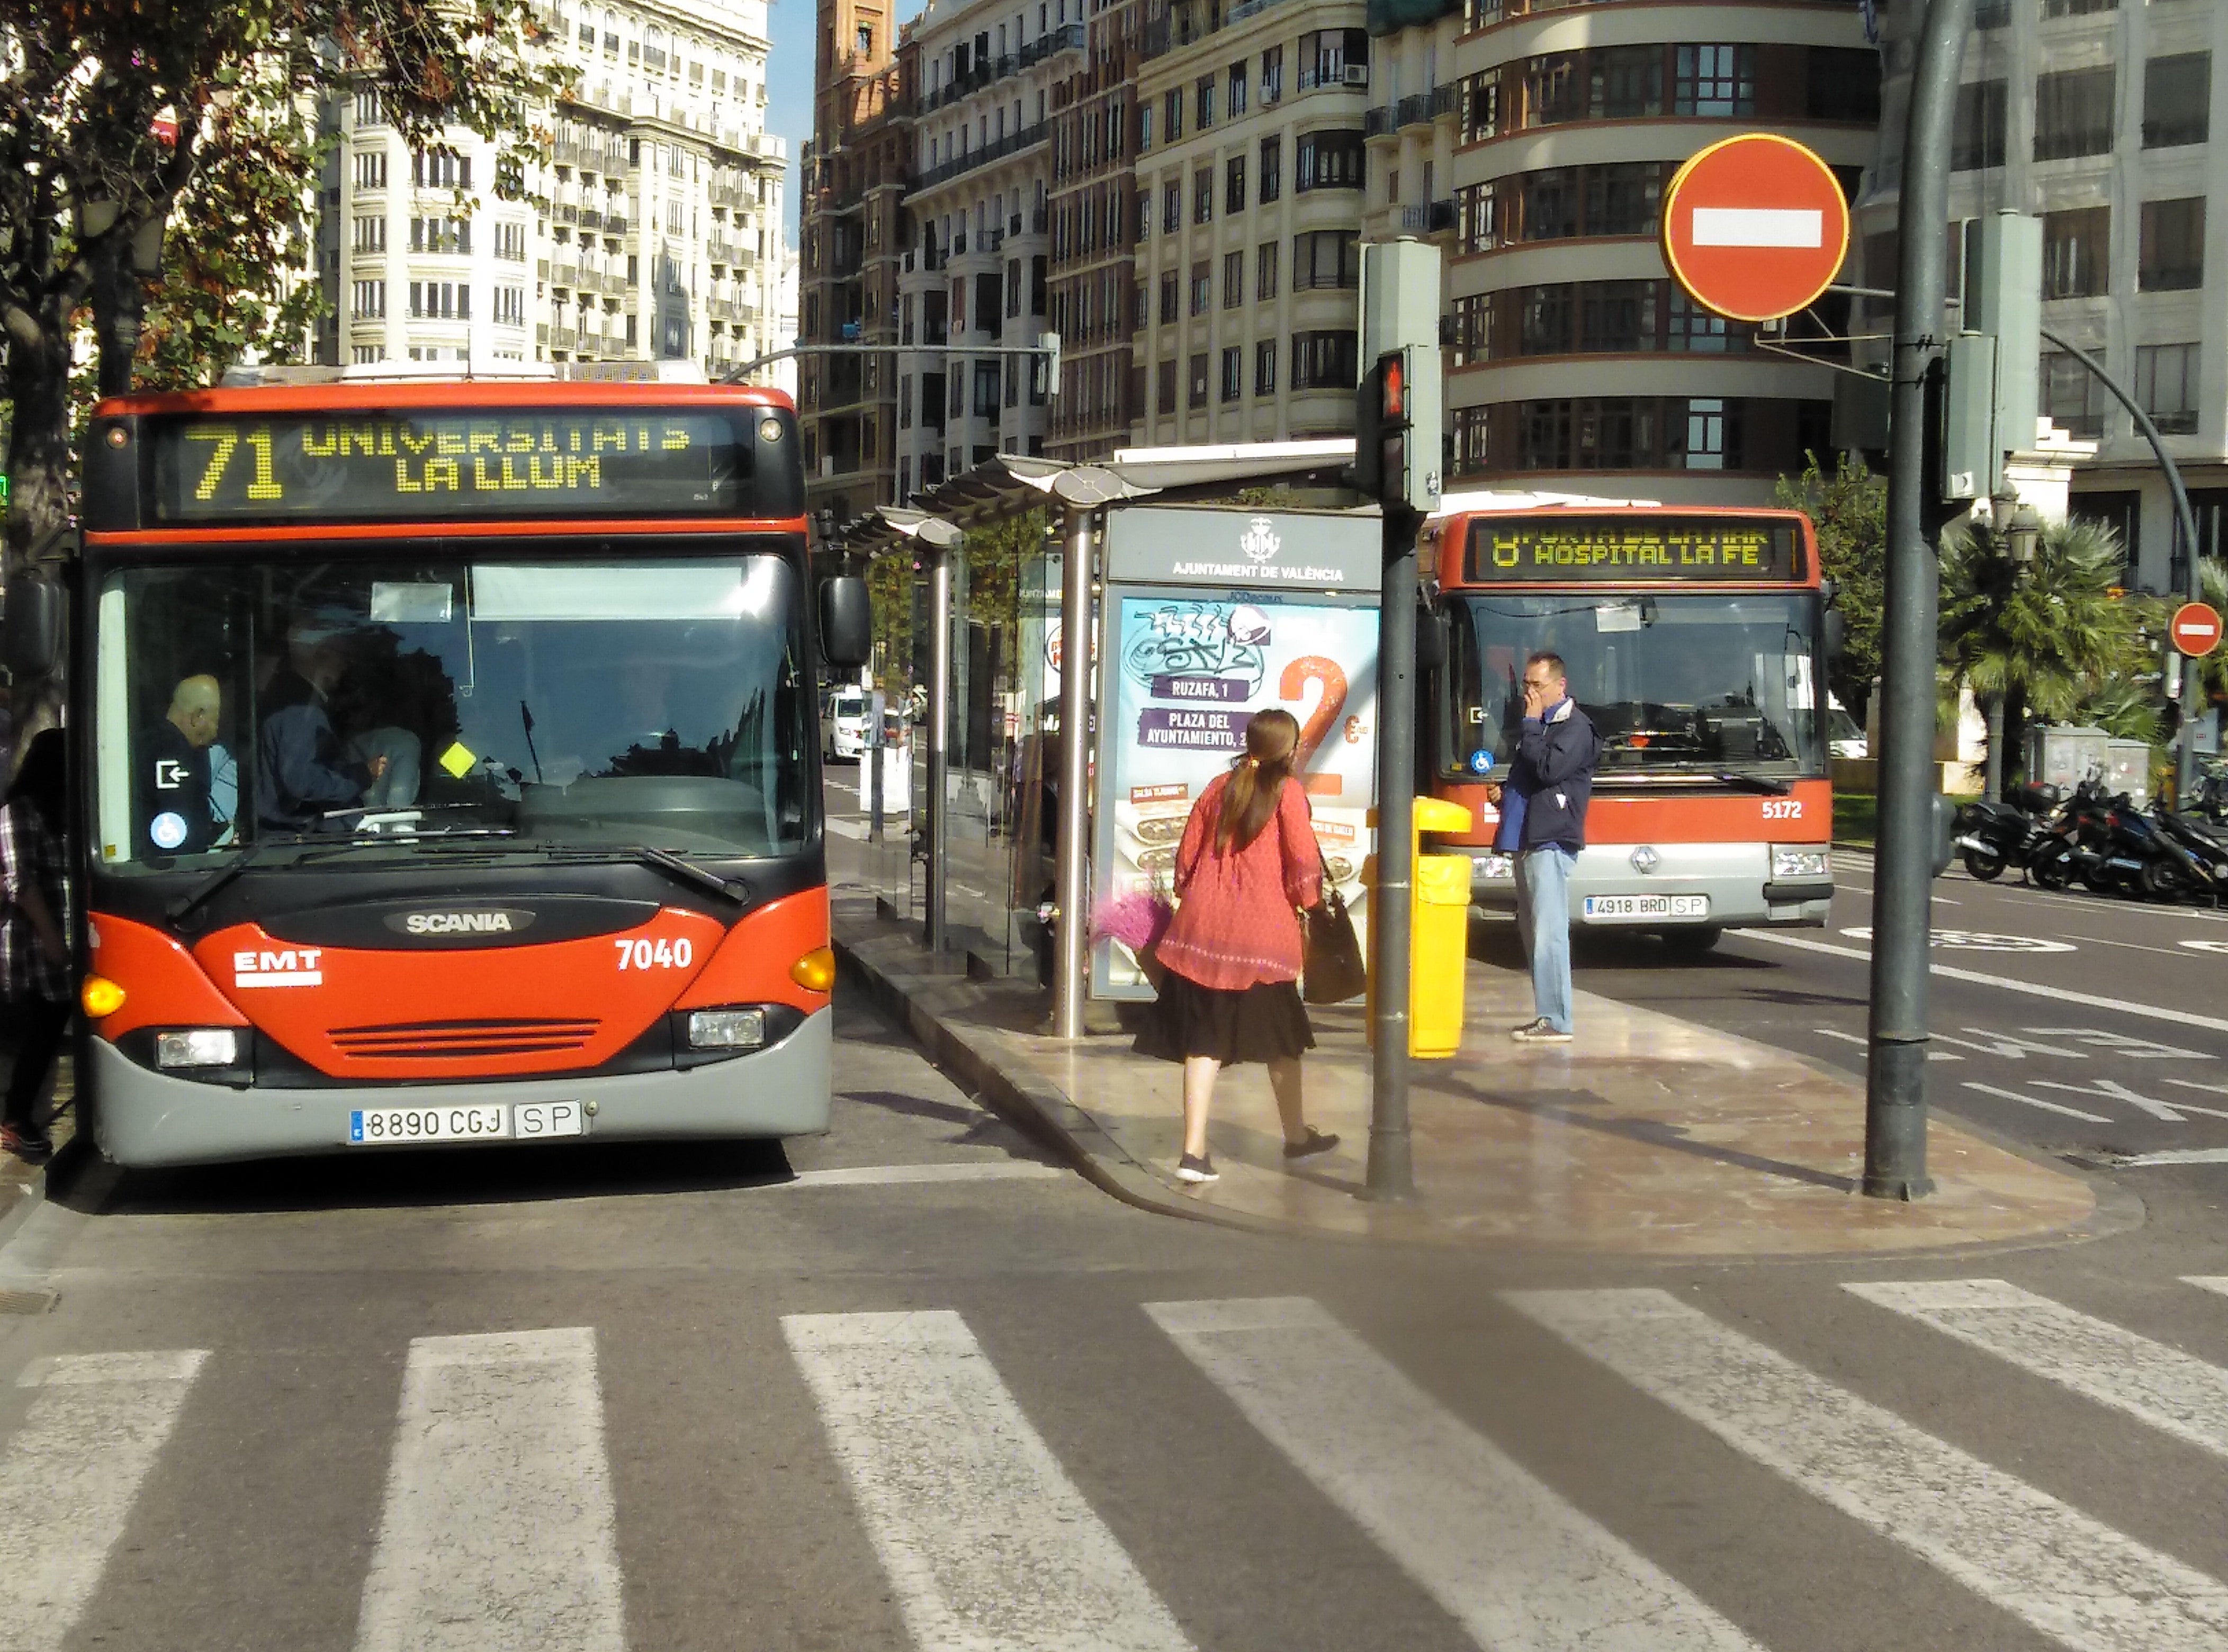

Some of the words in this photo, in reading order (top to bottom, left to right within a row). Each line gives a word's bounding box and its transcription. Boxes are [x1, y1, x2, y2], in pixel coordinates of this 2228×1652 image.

[185, 425, 282, 500] 71
[397, 456, 460, 492] LA
[474, 454, 600, 490] LLUM
[1535, 545, 1672, 565] HOSPITAL
[1681, 545, 1715, 565] LA
[1722, 545, 1759, 565] FE
[1172, 562, 1259, 578] AJUNTAMENT
[1260, 566, 1278, 579] DE
[1280, 565, 1343, 581] VALÈNCIA
[1172, 681, 1219, 699] RUZAFA,
[1221, 683, 1228, 697] 1
[1169, 712, 1206, 729] PLAZA
[1209, 714, 1230, 729] DEL
[1147, 730, 1237, 747] AYUNTAMIENTO,
[1762, 801, 1802, 819] 5172
[1597, 899, 1633, 913] 4918
[1640, 899, 1667, 912] BRD
[407, 913, 513, 933] SCANIA
[234, 950, 322, 972] EMT
[615, 938, 693, 970] 7040
[371, 1111, 439, 1136] 8890
[450, 1109, 500, 1134] CGJ
